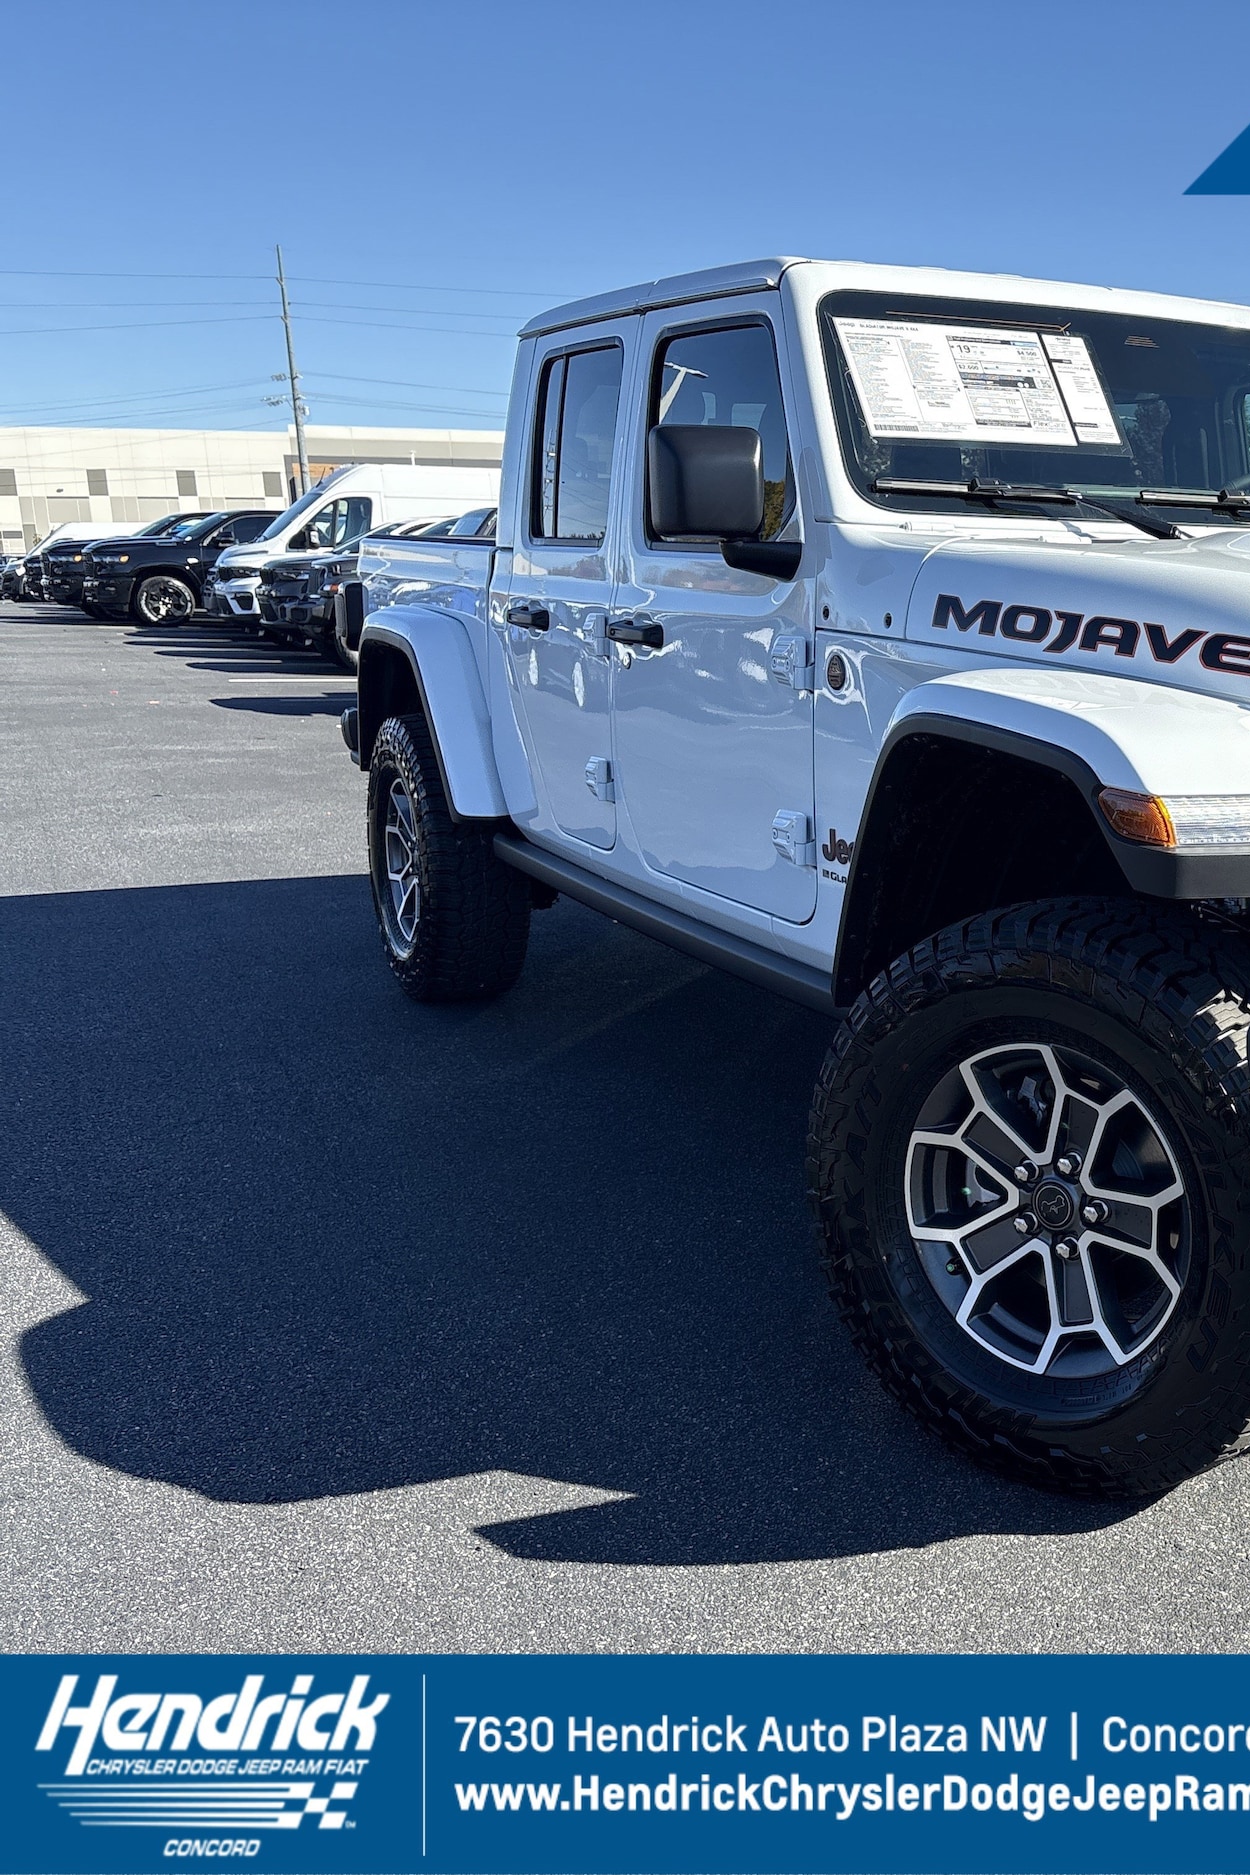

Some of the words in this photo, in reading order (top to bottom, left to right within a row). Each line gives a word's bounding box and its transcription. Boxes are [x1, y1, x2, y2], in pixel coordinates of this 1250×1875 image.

[956, 344, 971, 354] 19
[822, 828, 856, 865] Je
[1153, 1074, 1236, 1374] FALKEN
